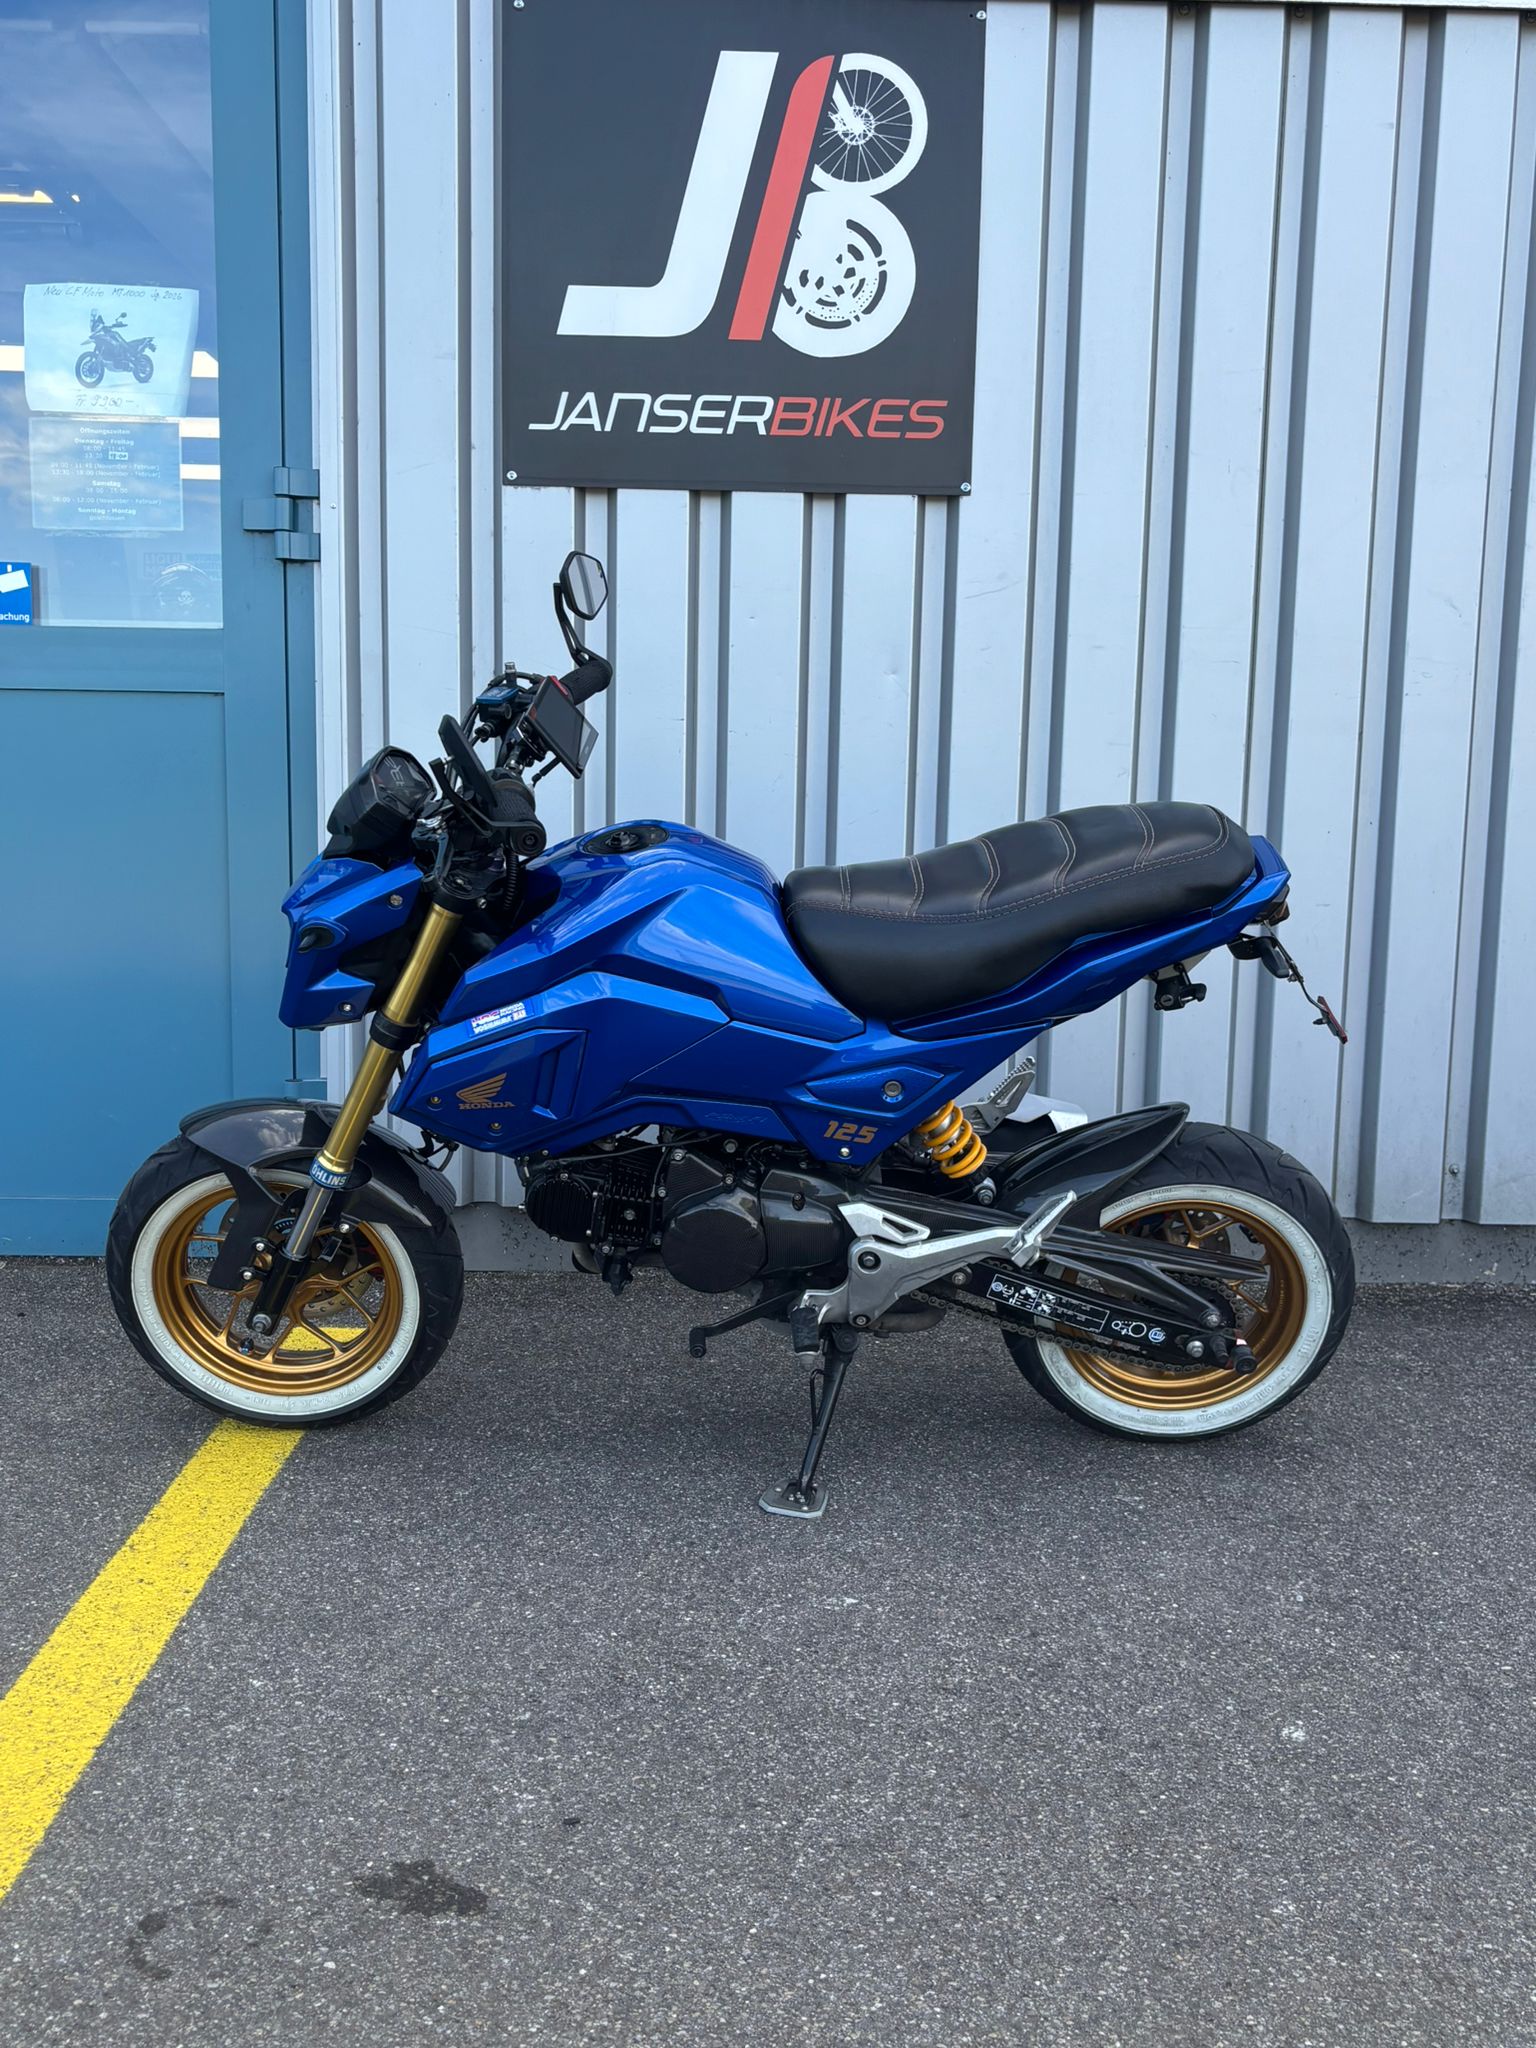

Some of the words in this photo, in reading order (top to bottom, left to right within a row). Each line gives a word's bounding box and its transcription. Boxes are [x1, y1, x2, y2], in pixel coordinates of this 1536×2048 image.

[529, 391, 948, 439] JANSERBIKES
[74, 438, 104, 446] Dienstag
[92, 480, 121, 488] Samstag
[78, 507, 106, 516] Sonntag
[112, 508, 137, 516] Montag
[459, 1101, 515, 1110] HONDA
[824, 1120, 878, 1144] 125
